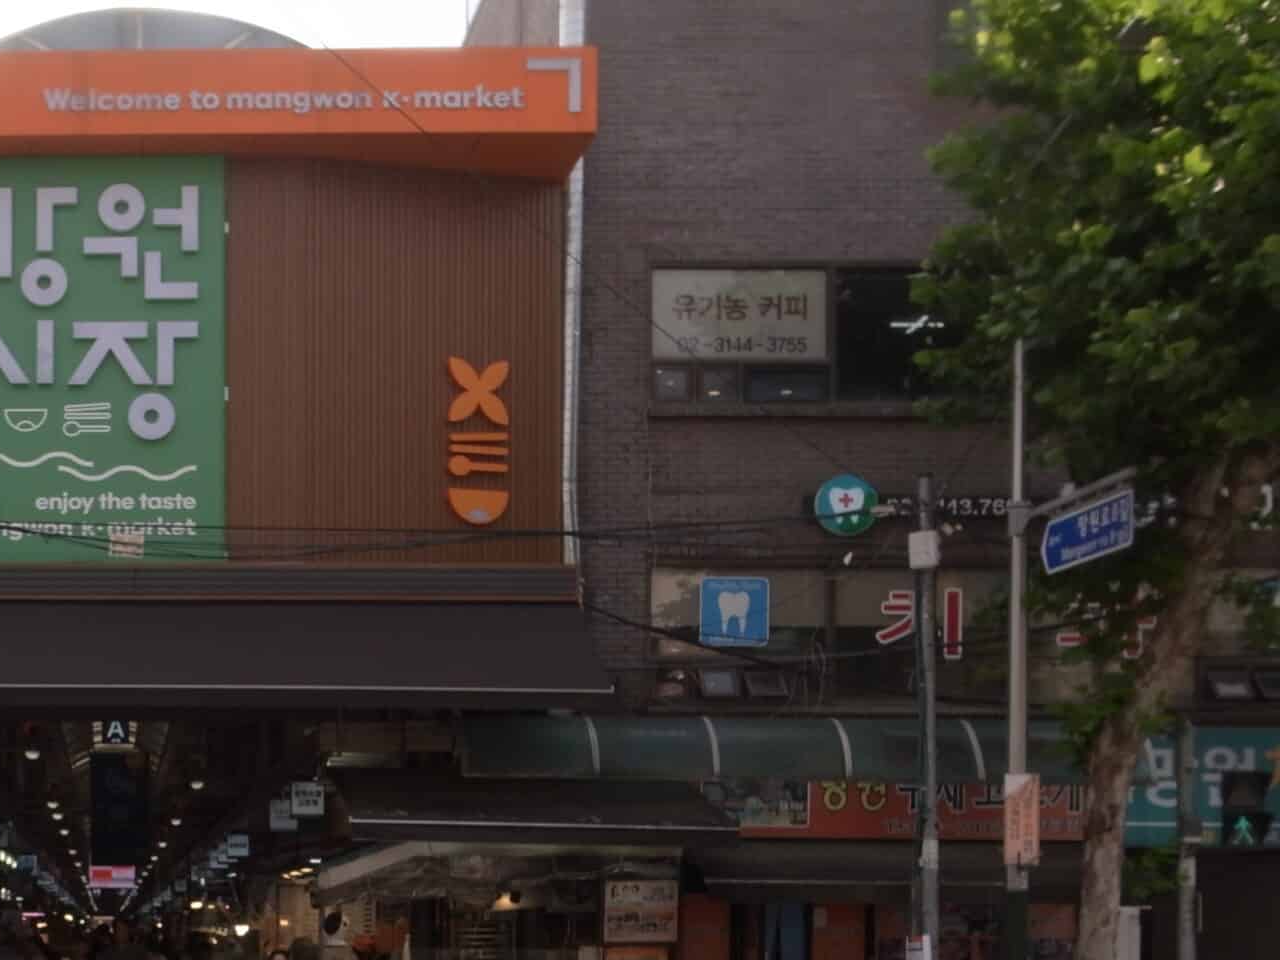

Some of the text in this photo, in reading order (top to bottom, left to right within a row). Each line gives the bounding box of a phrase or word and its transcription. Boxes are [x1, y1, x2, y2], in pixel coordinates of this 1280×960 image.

[42, 86, 180, 112] Welcome
[189, 88, 220, 111] to
[226, 90, 373, 114] mangwon
[672, 292, 809, 321] 유기농 커피
[674, 336, 808, 353] 02-3144-3755
[35, 492, 197, 514] enjoy the taste
